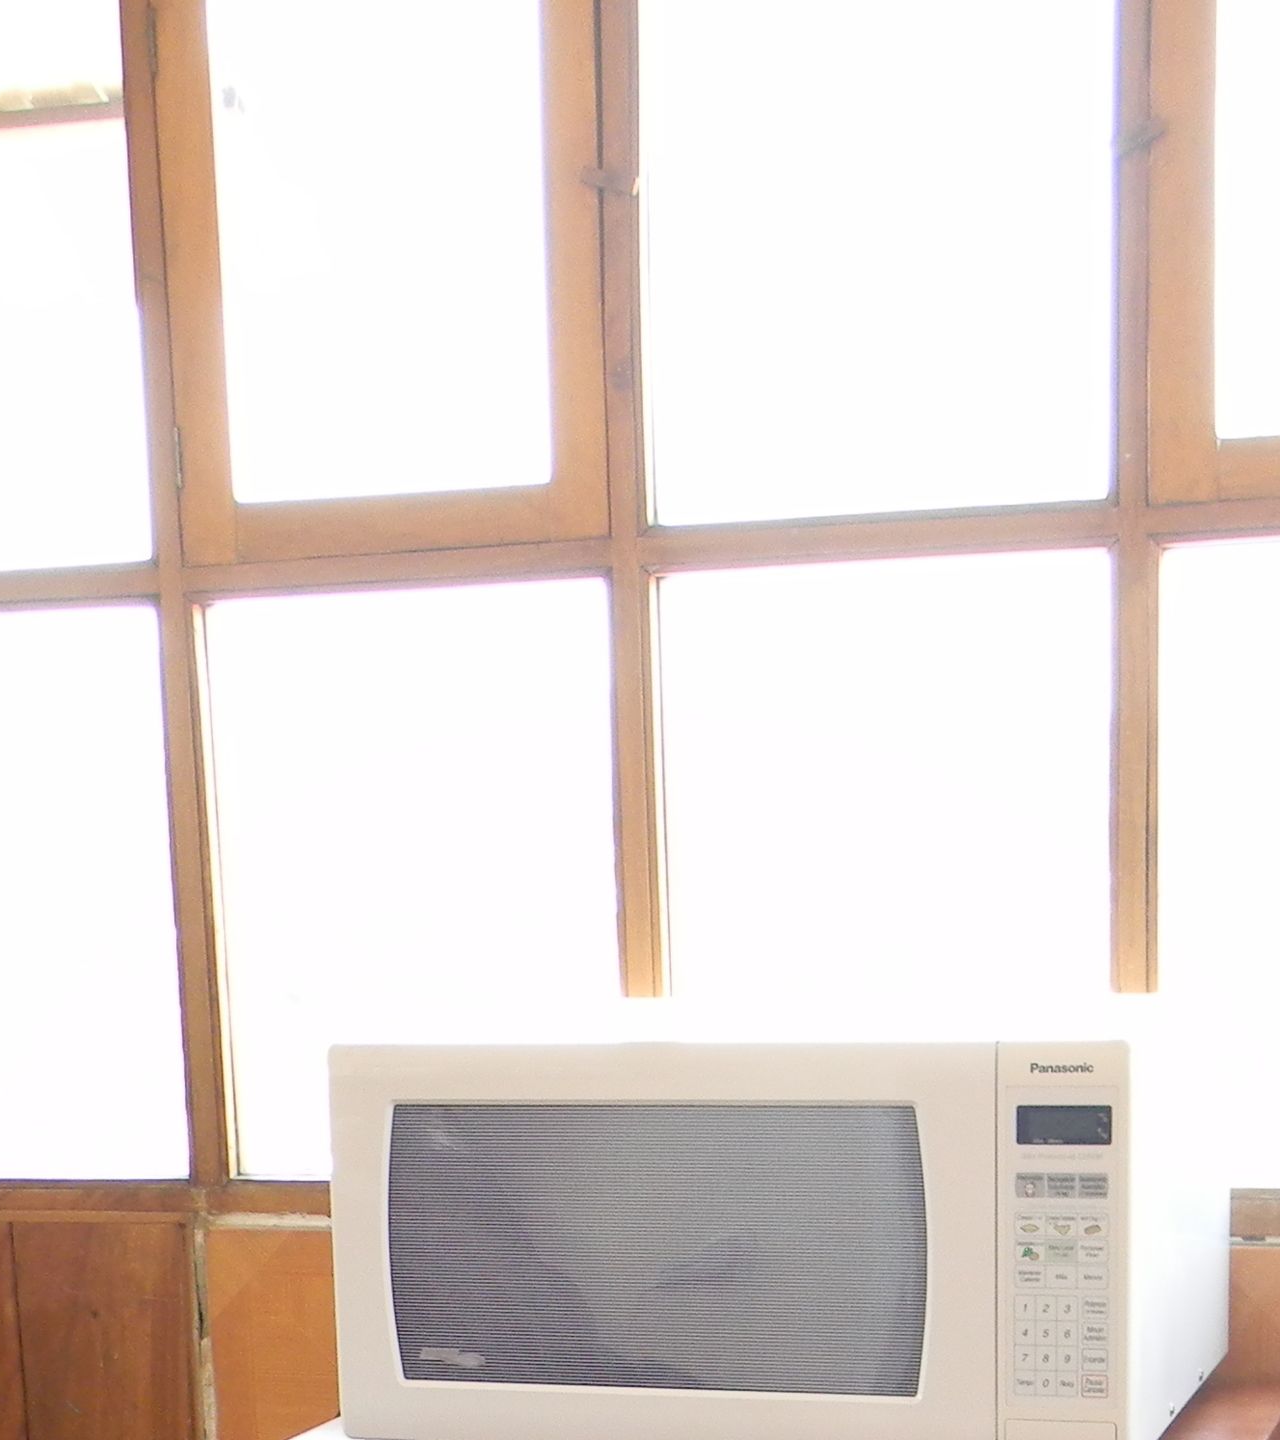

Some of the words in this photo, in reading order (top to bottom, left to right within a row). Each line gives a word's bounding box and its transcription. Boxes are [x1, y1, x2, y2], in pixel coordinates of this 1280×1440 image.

[1030, 1062, 1095, 1075] Panasonic
[1042, 1303, 1050, 1313] 2
[1063, 1304, 1071, 1314] 3
[1022, 1328, 1029, 1338] 4
[1042, 1328, 1050, 1338] 5
[1063, 1329, 1071, 1339] 6
[1021, 1353, 1029, 1363] 7
[1042, 1353, 1050, 1363] 8
[1063, 1354, 1071, 1364] 9
[1042, 1378, 1050, 1388] 0
